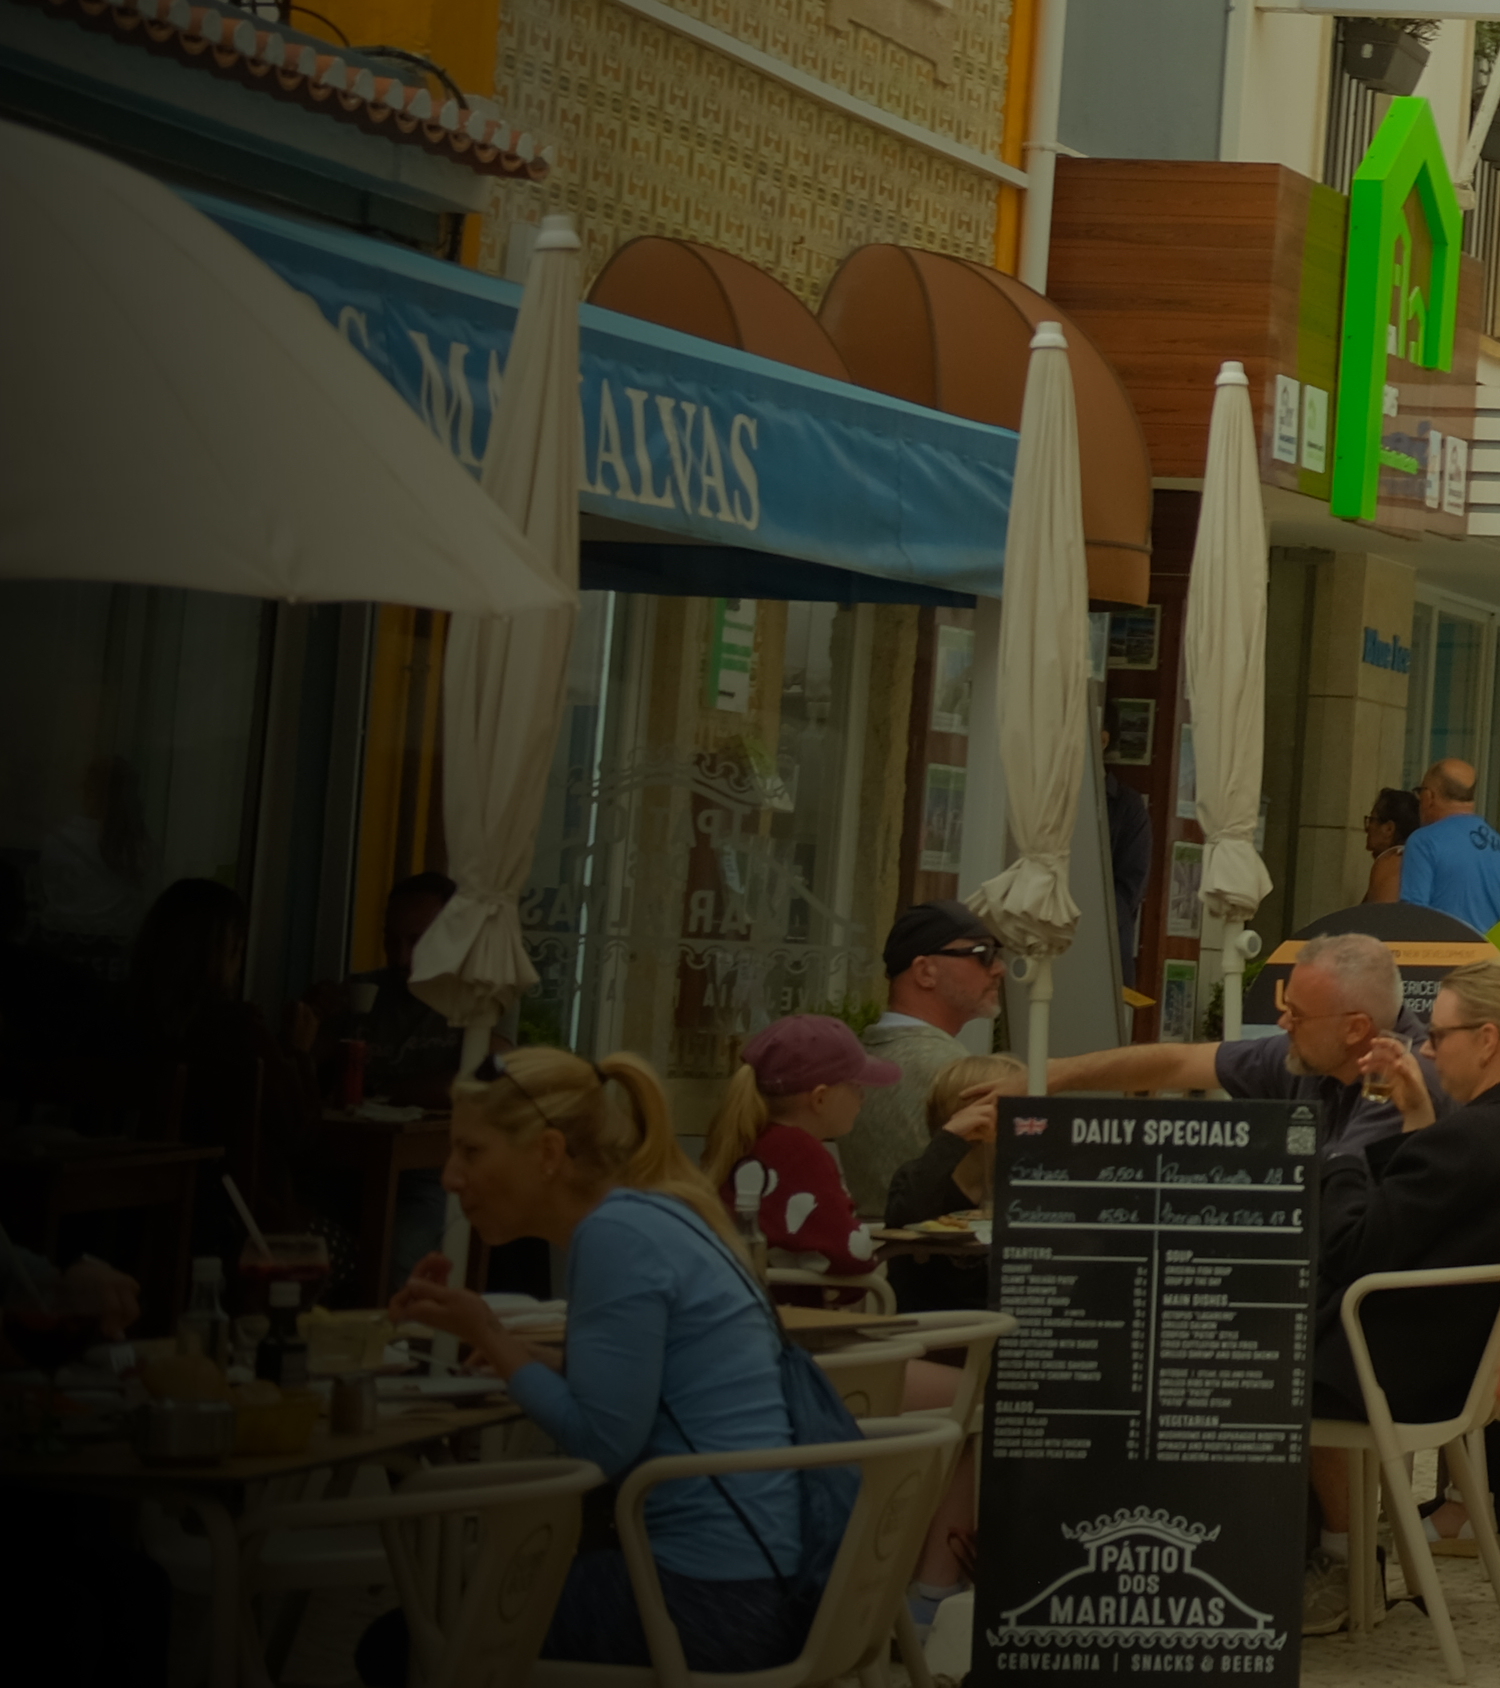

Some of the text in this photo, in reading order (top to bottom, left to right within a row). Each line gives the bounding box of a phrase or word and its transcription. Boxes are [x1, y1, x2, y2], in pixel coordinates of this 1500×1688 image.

[1071, 1117, 1250, 1148] DAILY SPECIALS
[1163, 1293, 1191, 1306] MAIN
[1101, 1540, 1179, 1573] PÁTIO
[1118, 1574, 1160, 1594] DOS
[1050, 1595, 1226, 1626] MARIALVAS
[997, 1652, 1100, 1671] CERVEJARIA
[1131, 1653, 1195, 1672] SNACKS
[1220, 1654, 1275, 1673] BEERS
